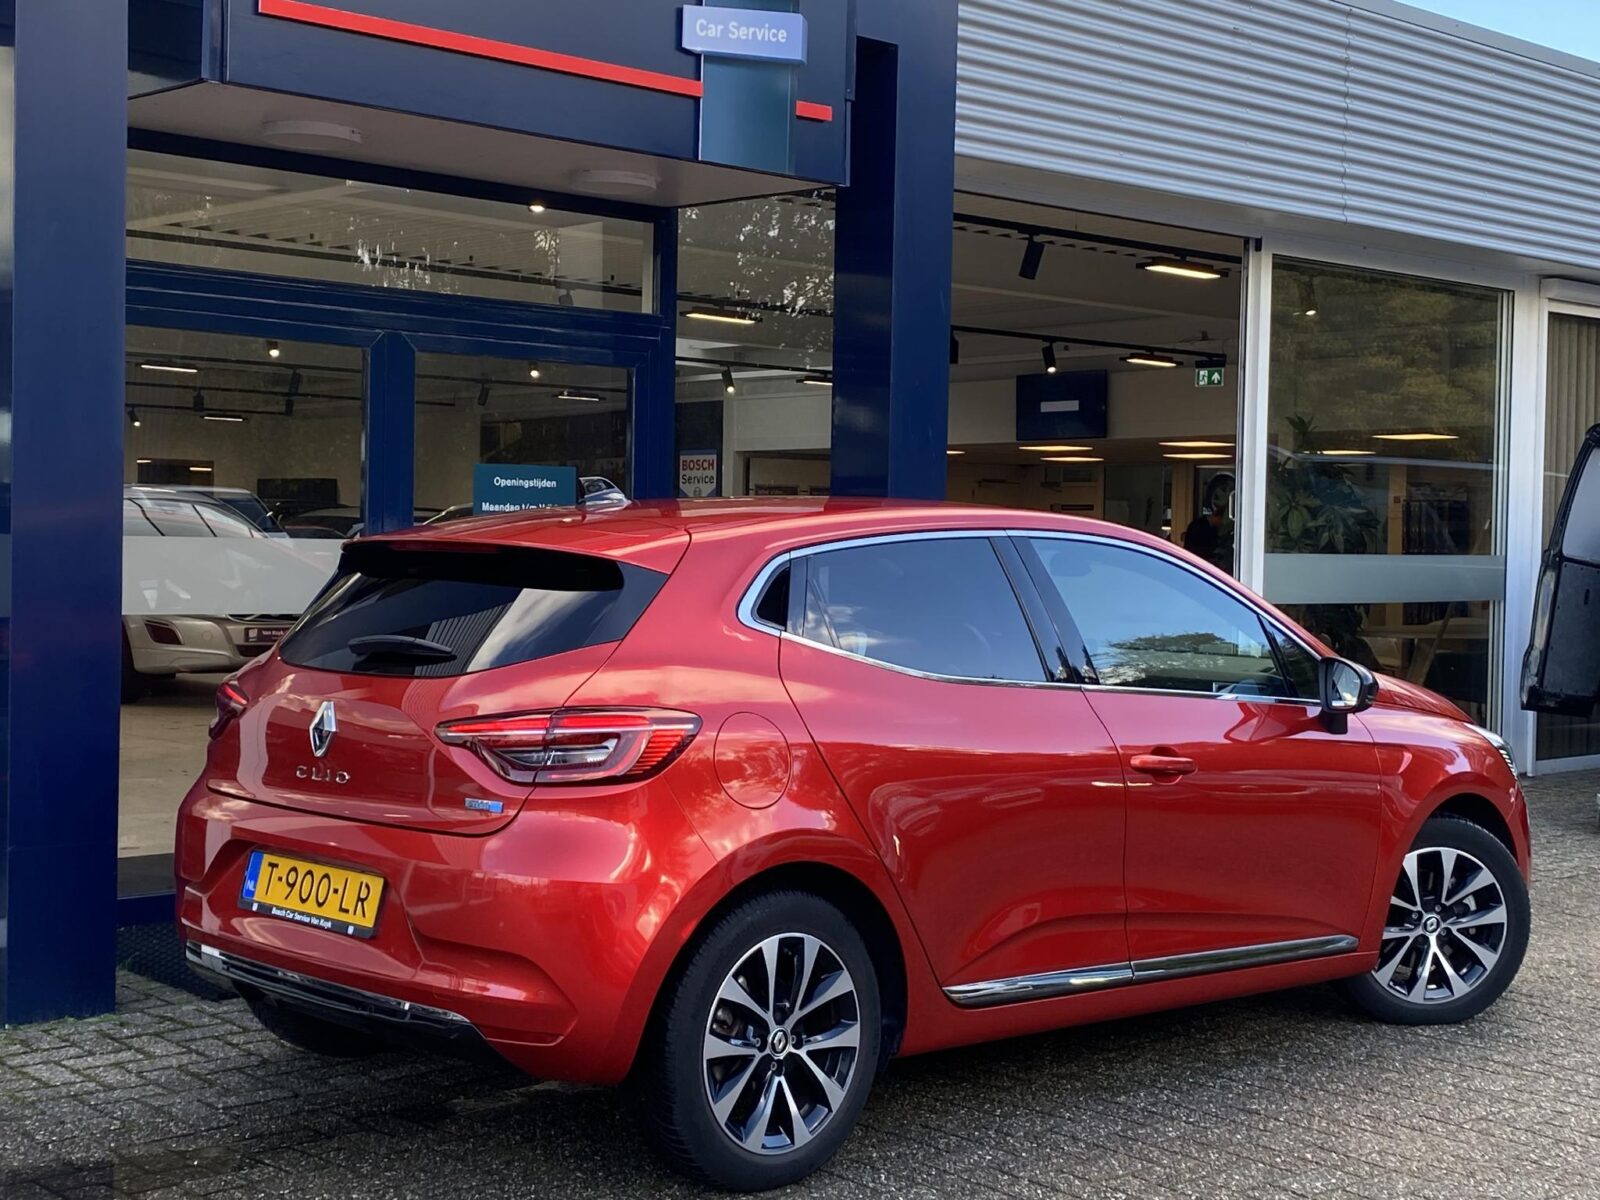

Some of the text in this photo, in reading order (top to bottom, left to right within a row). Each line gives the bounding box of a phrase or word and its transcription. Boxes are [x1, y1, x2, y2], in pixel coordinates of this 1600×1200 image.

[695, 19, 788, 43] Car Service
[681, 459, 715, 471] BOSCH
[493, 476, 557, 489] Openingstijden
[681, 473, 715, 485] Service
[295, 765, 351, 784] CLIO
[246, 879, 256, 891] NL
[264, 861, 372, 919] T-900-LR
[271, 906, 286, 917] Bosch
[285, 910, 294, 919] Car
